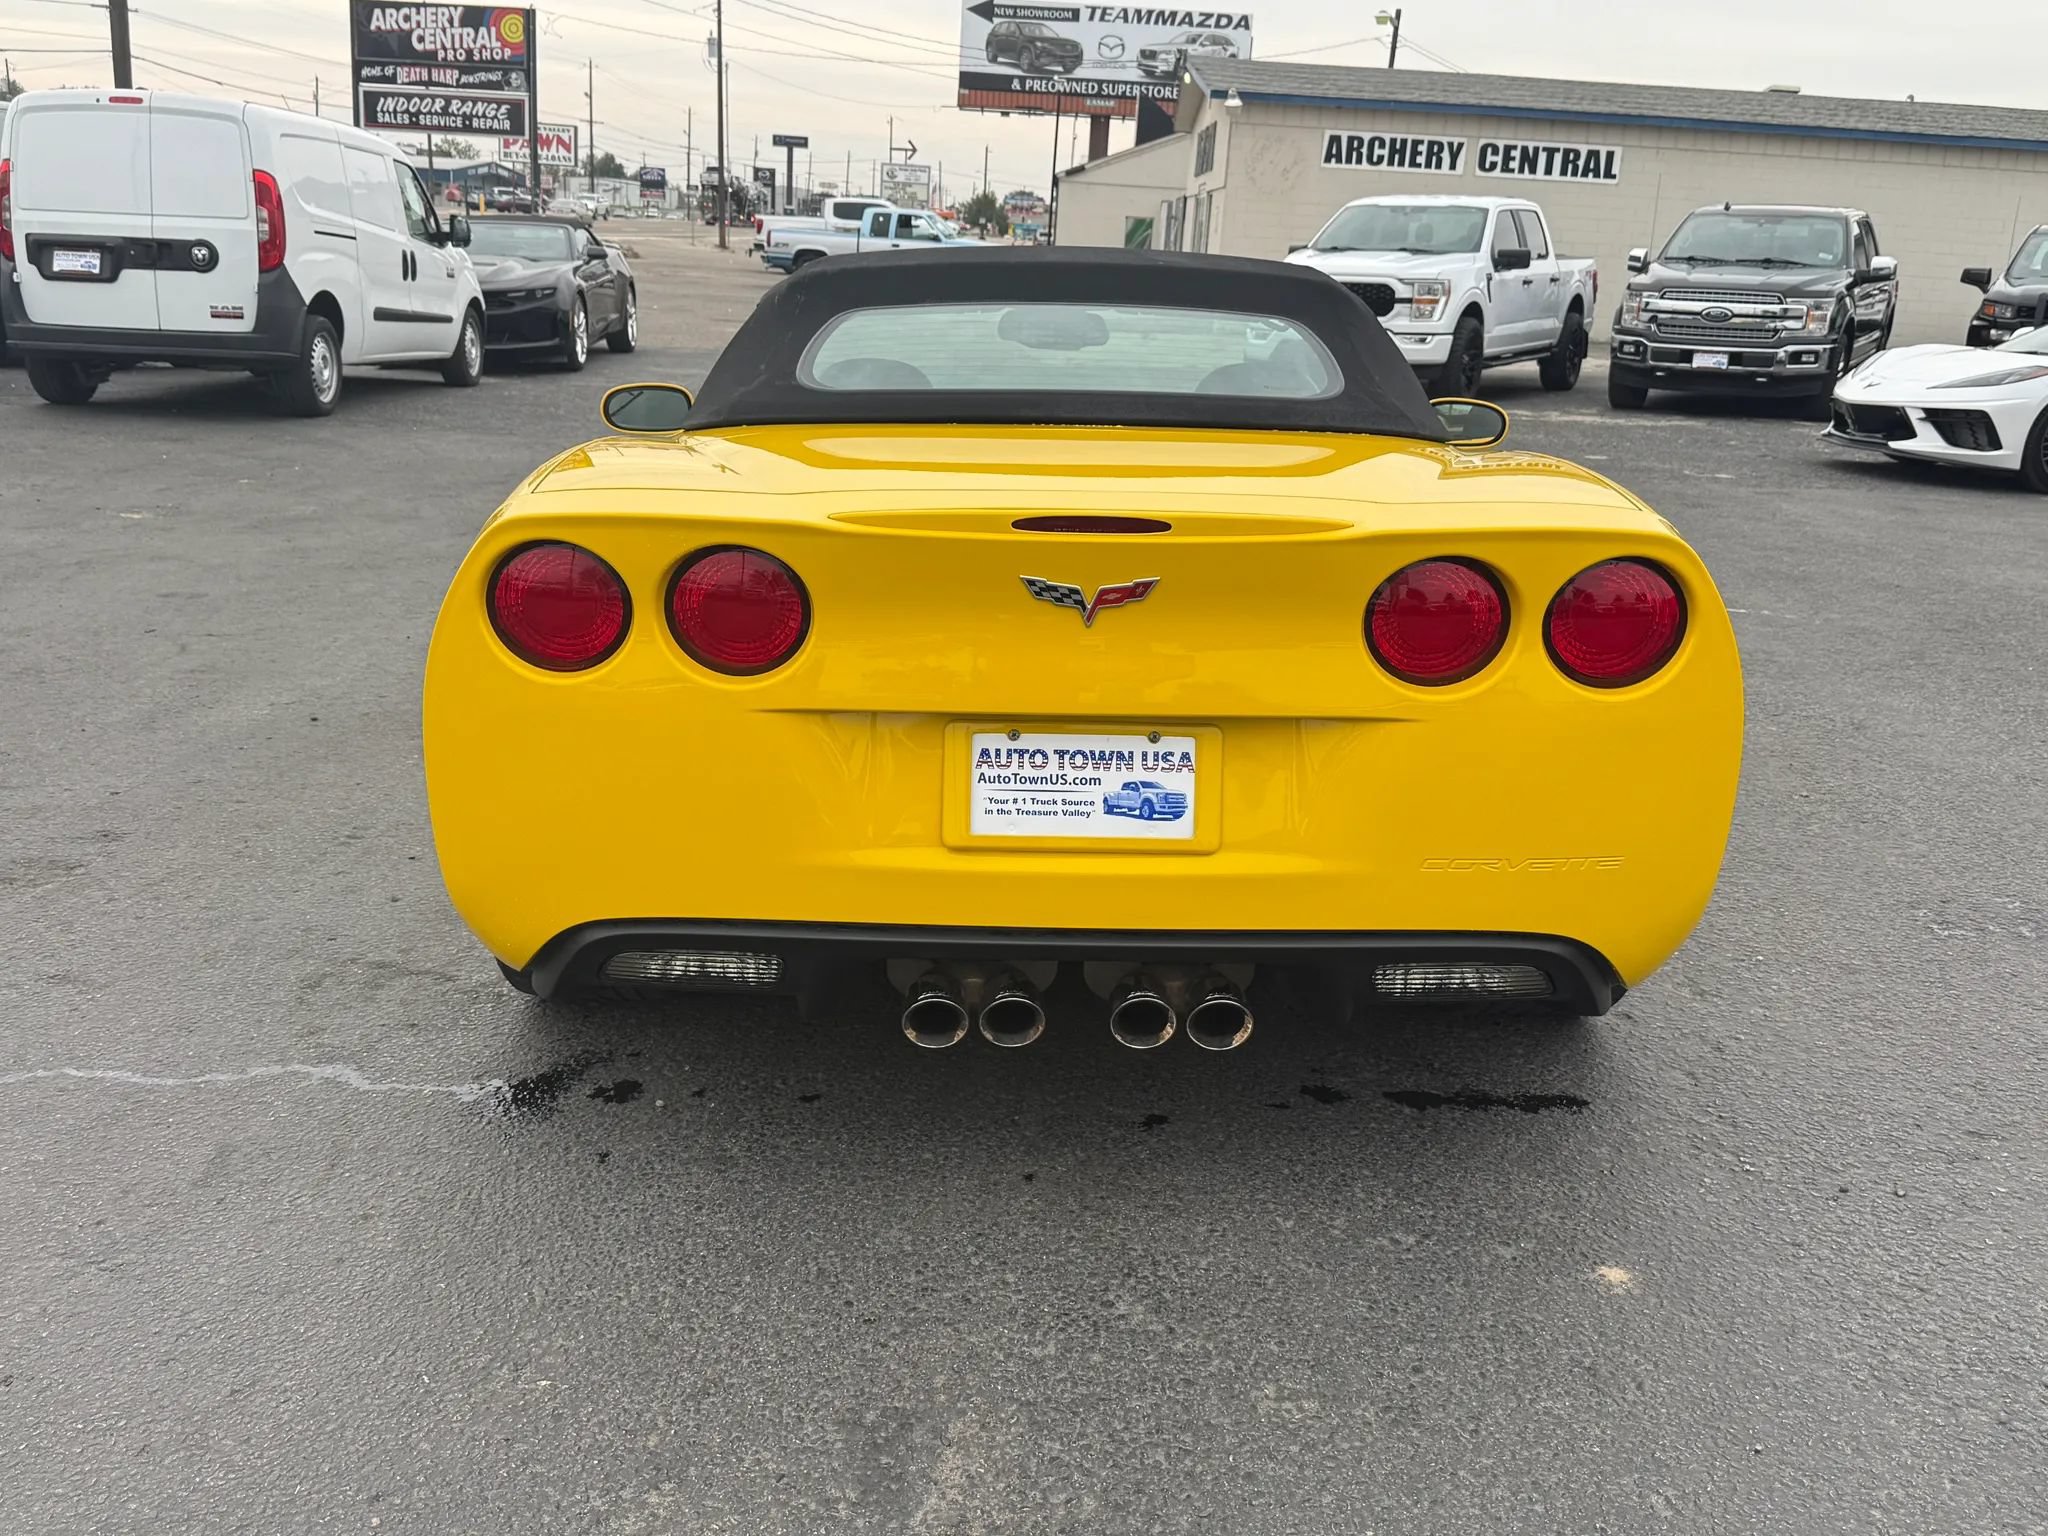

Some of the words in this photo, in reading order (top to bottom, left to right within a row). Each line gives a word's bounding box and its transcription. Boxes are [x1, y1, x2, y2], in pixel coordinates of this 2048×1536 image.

[370, 6, 465, 31] ARCHERY
[994, 7, 1015, 17] NEW
[1016, 8, 1073, 19] SHOWROOM
[1084, 5, 1251, 31] TEAMMAZDA
[411, 26, 501, 50] CENTRAL
[437, 49, 466, 61] PRO
[472, 48, 512, 61] SHOP
[361, 66, 384, 79] HOME
[384, 65, 395, 77] OF
[396, 66, 429, 84] DEATH
[431, 67, 460, 86] HARP
[459, 70, 503, 84] BOWSTRINGS
[1011, 79, 1021, 91] &
[1025, 79, 1099, 95] PREOWNED
[376, 96, 445, 113] INDOOR
[448, 99, 511, 119] RANGE
[377, 112, 410, 125] SALES
[419, 114, 463, 128] SERVICE
[472, 117, 511, 131] REPAIR
[503, 133, 572, 154] PAWN
[1323, 134, 1465, 171] ARCHERY
[1477, 142, 1617, 180] CENTRAL
[975, 747, 1049, 770] AUTO
[1053, 749, 1134, 773] TOWN
[1141, 750, 1195, 774] USA
[977, 772, 1102, 787] AutoTownUS.com
[984, 807, 993, 816] in
[996, 807, 1012, 816] the
[1015, 808, 1059, 817] Treasure
[1030, 797, 1058, 806] Truck
[1061, 798, 1096, 807] Source
[1420, 856, 1625, 872] CORVETTE
